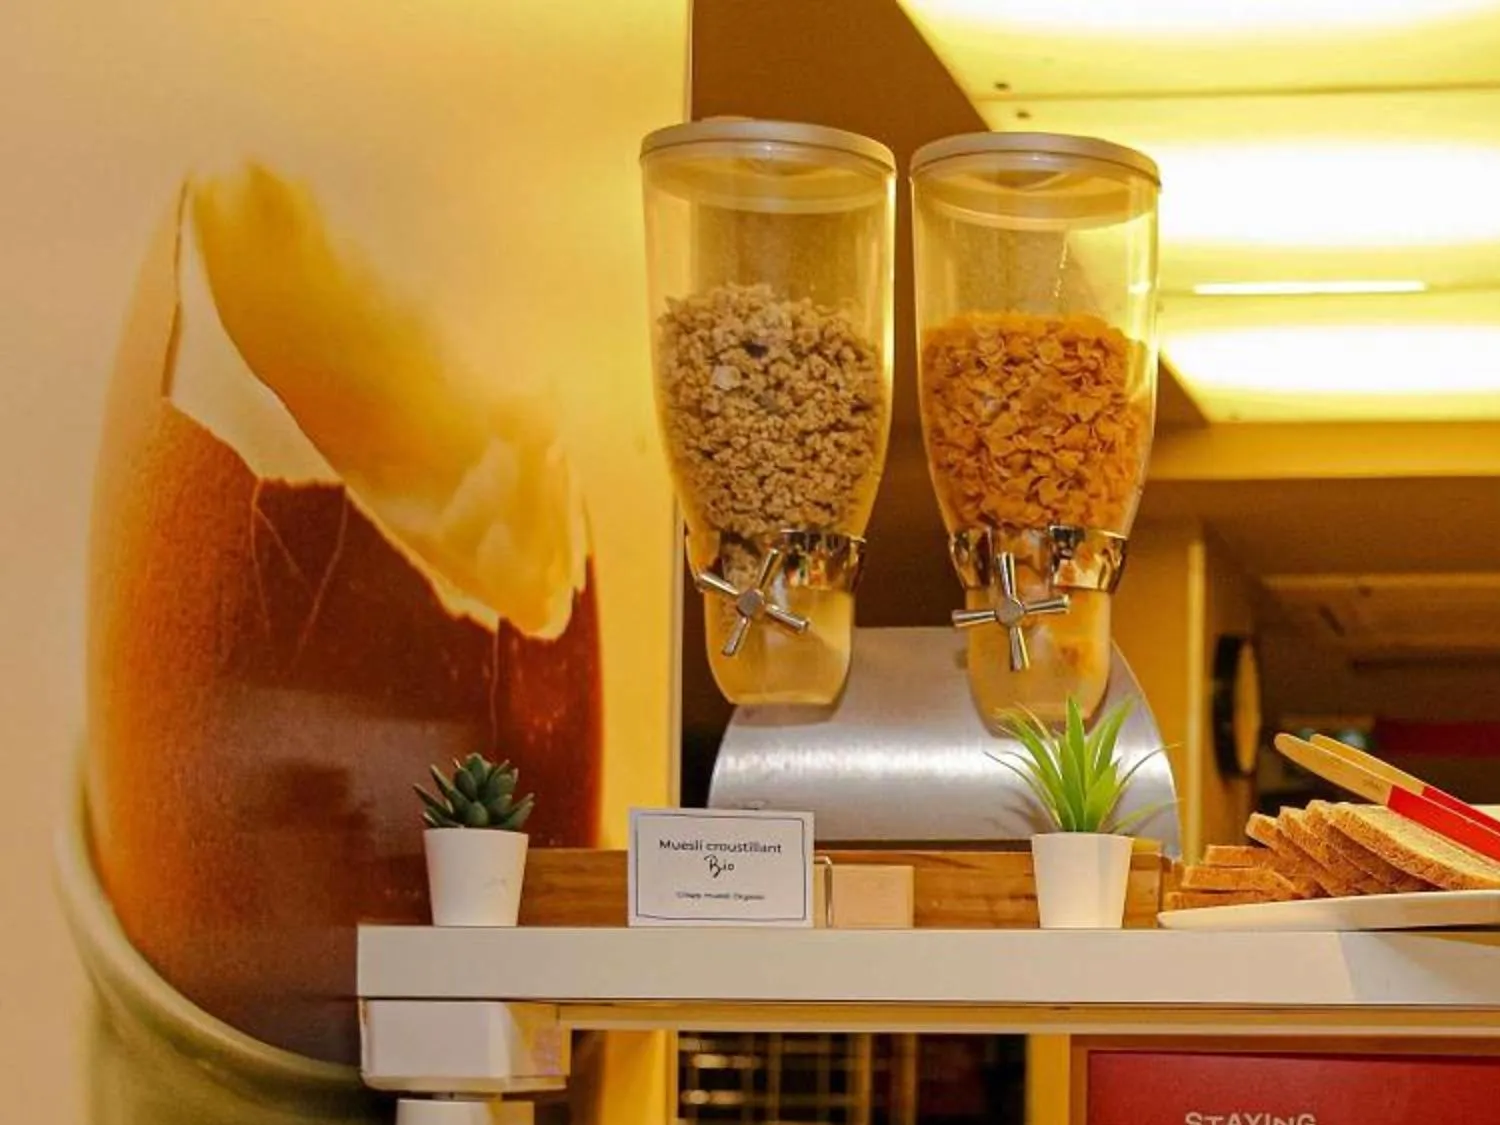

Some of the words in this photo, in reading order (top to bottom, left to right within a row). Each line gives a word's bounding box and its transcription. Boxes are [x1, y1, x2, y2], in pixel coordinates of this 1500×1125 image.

[658, 838, 703, 852] Muesli
[706, 840, 782, 853] croustillant
[704, 854, 735, 878] Bio
